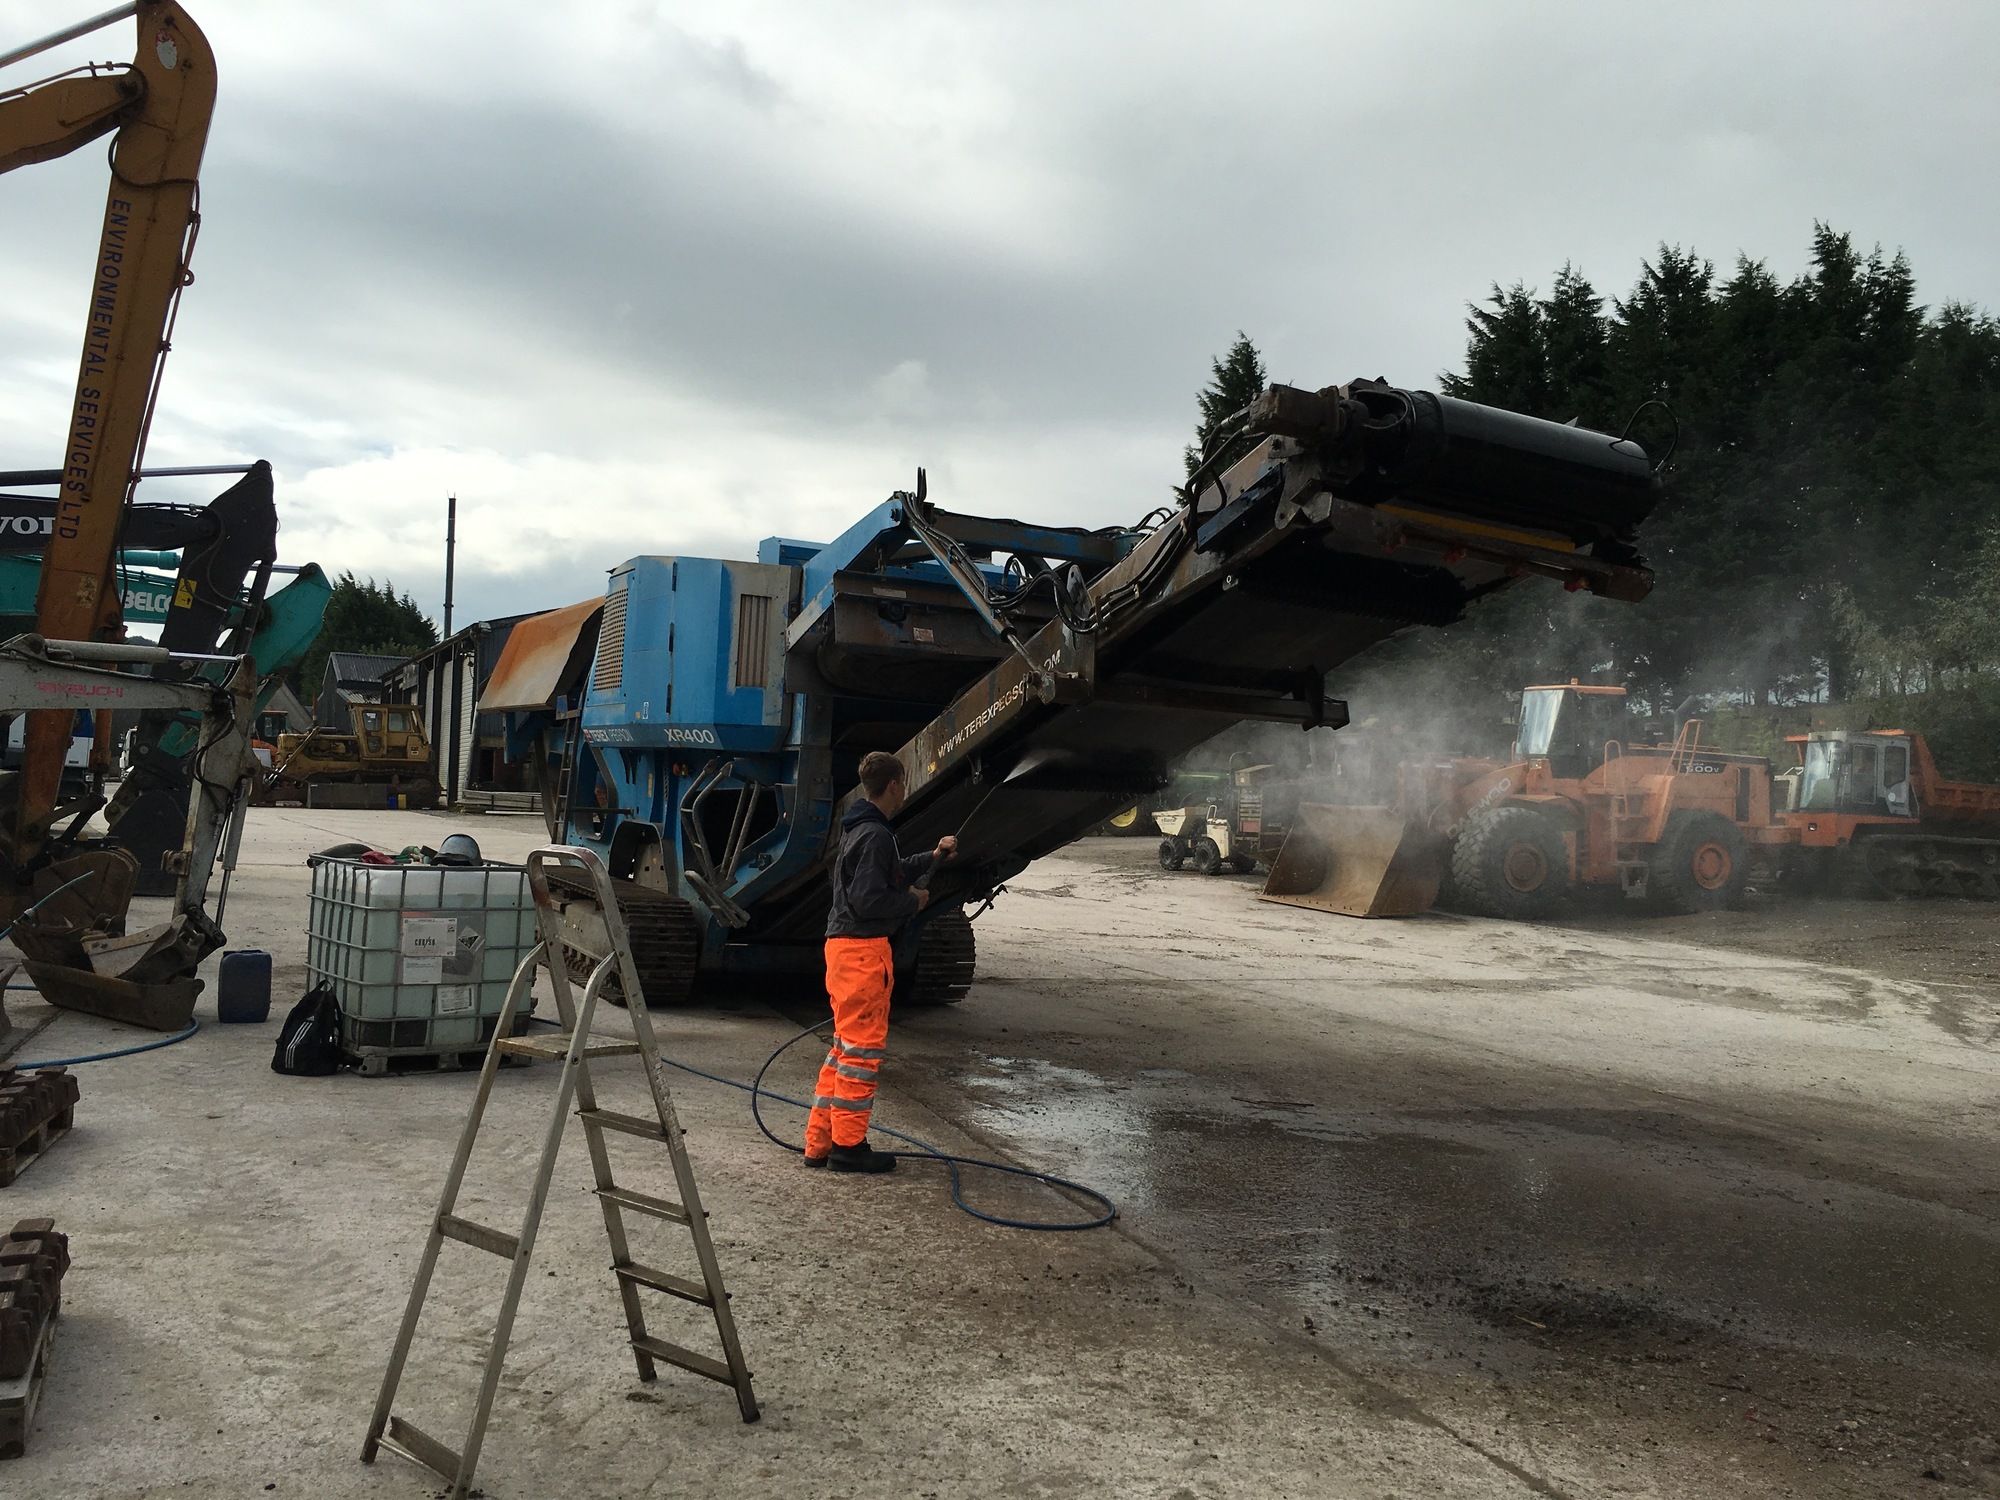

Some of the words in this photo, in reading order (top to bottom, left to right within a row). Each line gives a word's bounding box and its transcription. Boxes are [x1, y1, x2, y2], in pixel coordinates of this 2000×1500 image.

[85, 199, 131, 377] ENVIRONMENTAL
[66, 386, 100, 492] SERVICES
[59, 502, 84, 539] LTD
[119, 589, 172, 613] BELC
[664, 728, 715, 744] XR400
